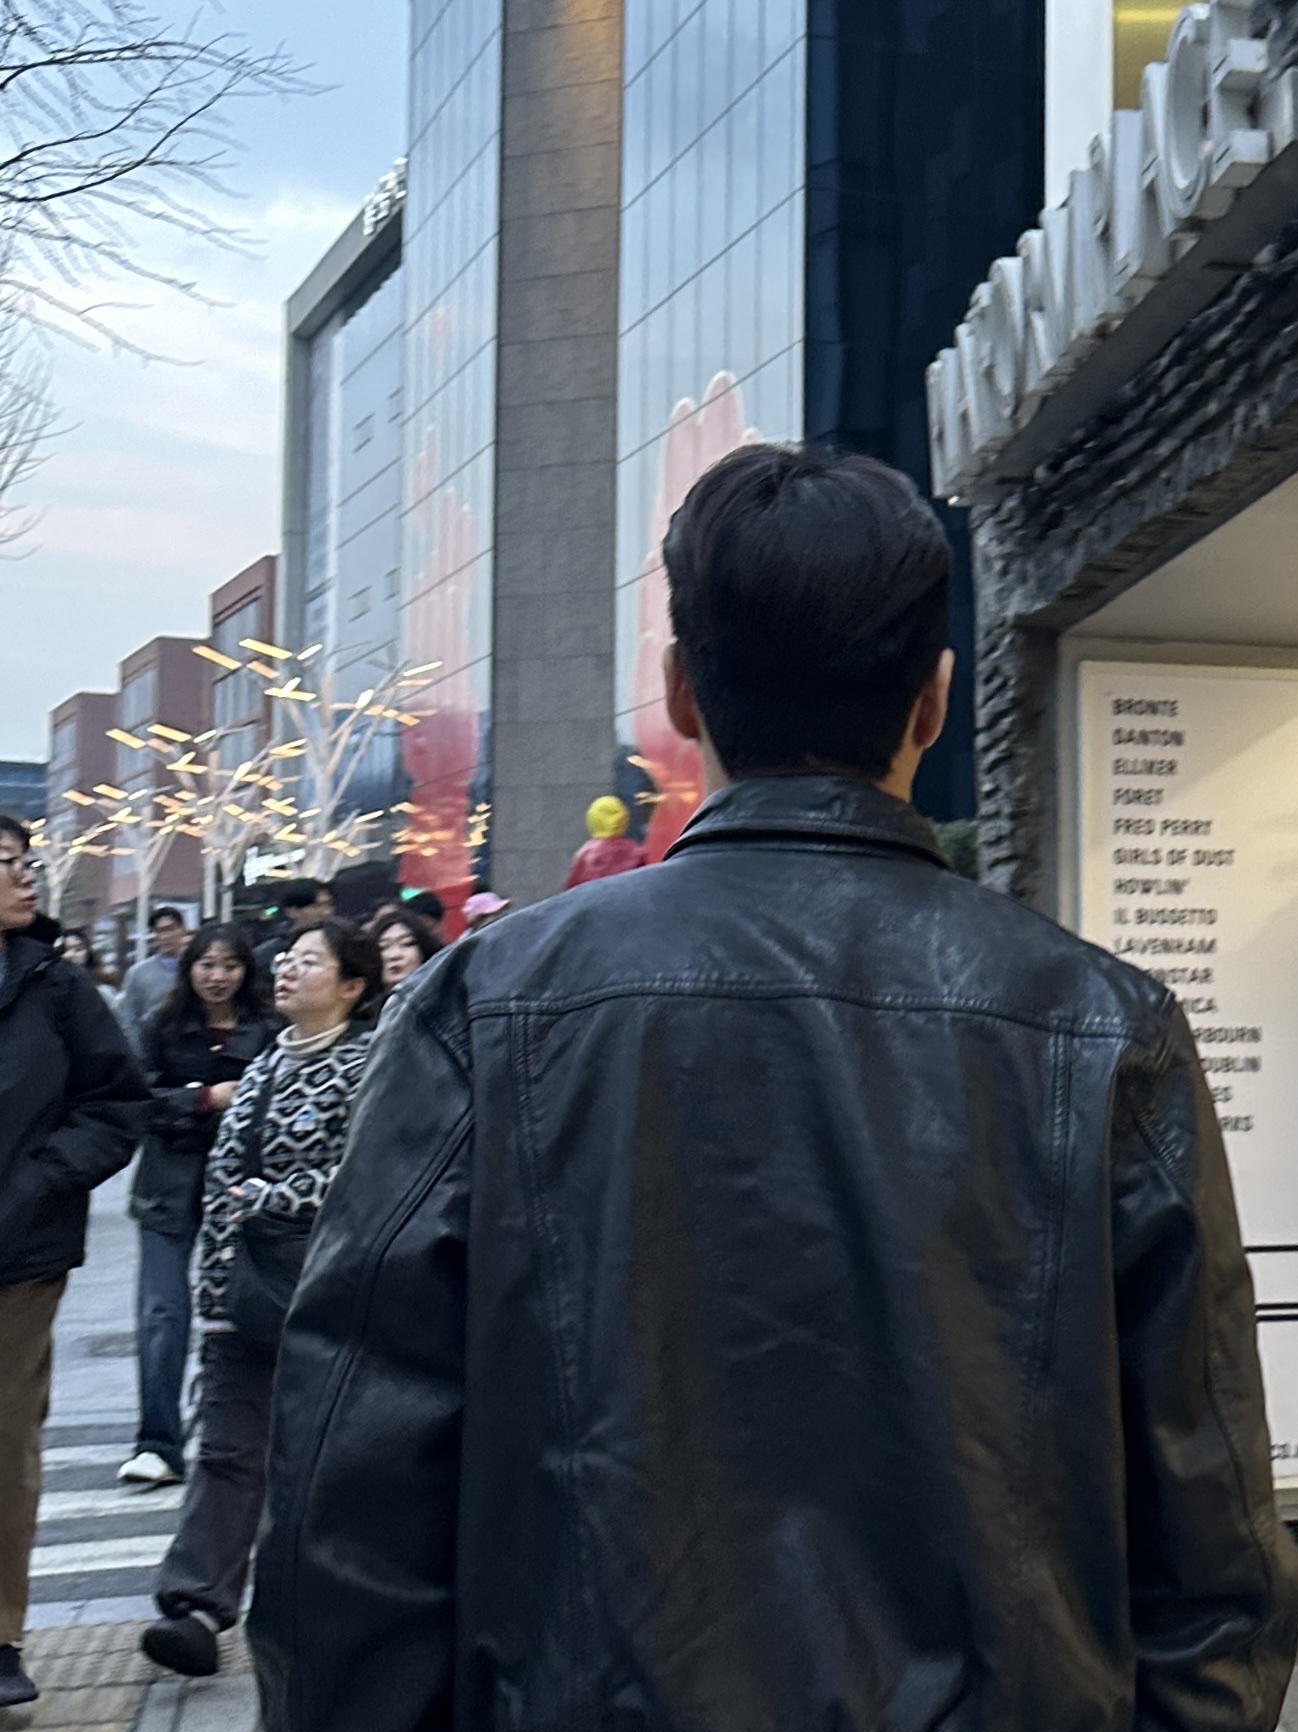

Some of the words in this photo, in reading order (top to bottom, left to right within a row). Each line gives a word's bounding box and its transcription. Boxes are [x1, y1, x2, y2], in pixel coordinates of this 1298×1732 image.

[1113, 818, 1155, 835] FRED
[1160, 819, 1212, 836] PERRY
[1113, 848, 1161, 865] GIRLS
[1166, 849, 1188, 865] OF
[1191, 849, 1235, 866] DUST
